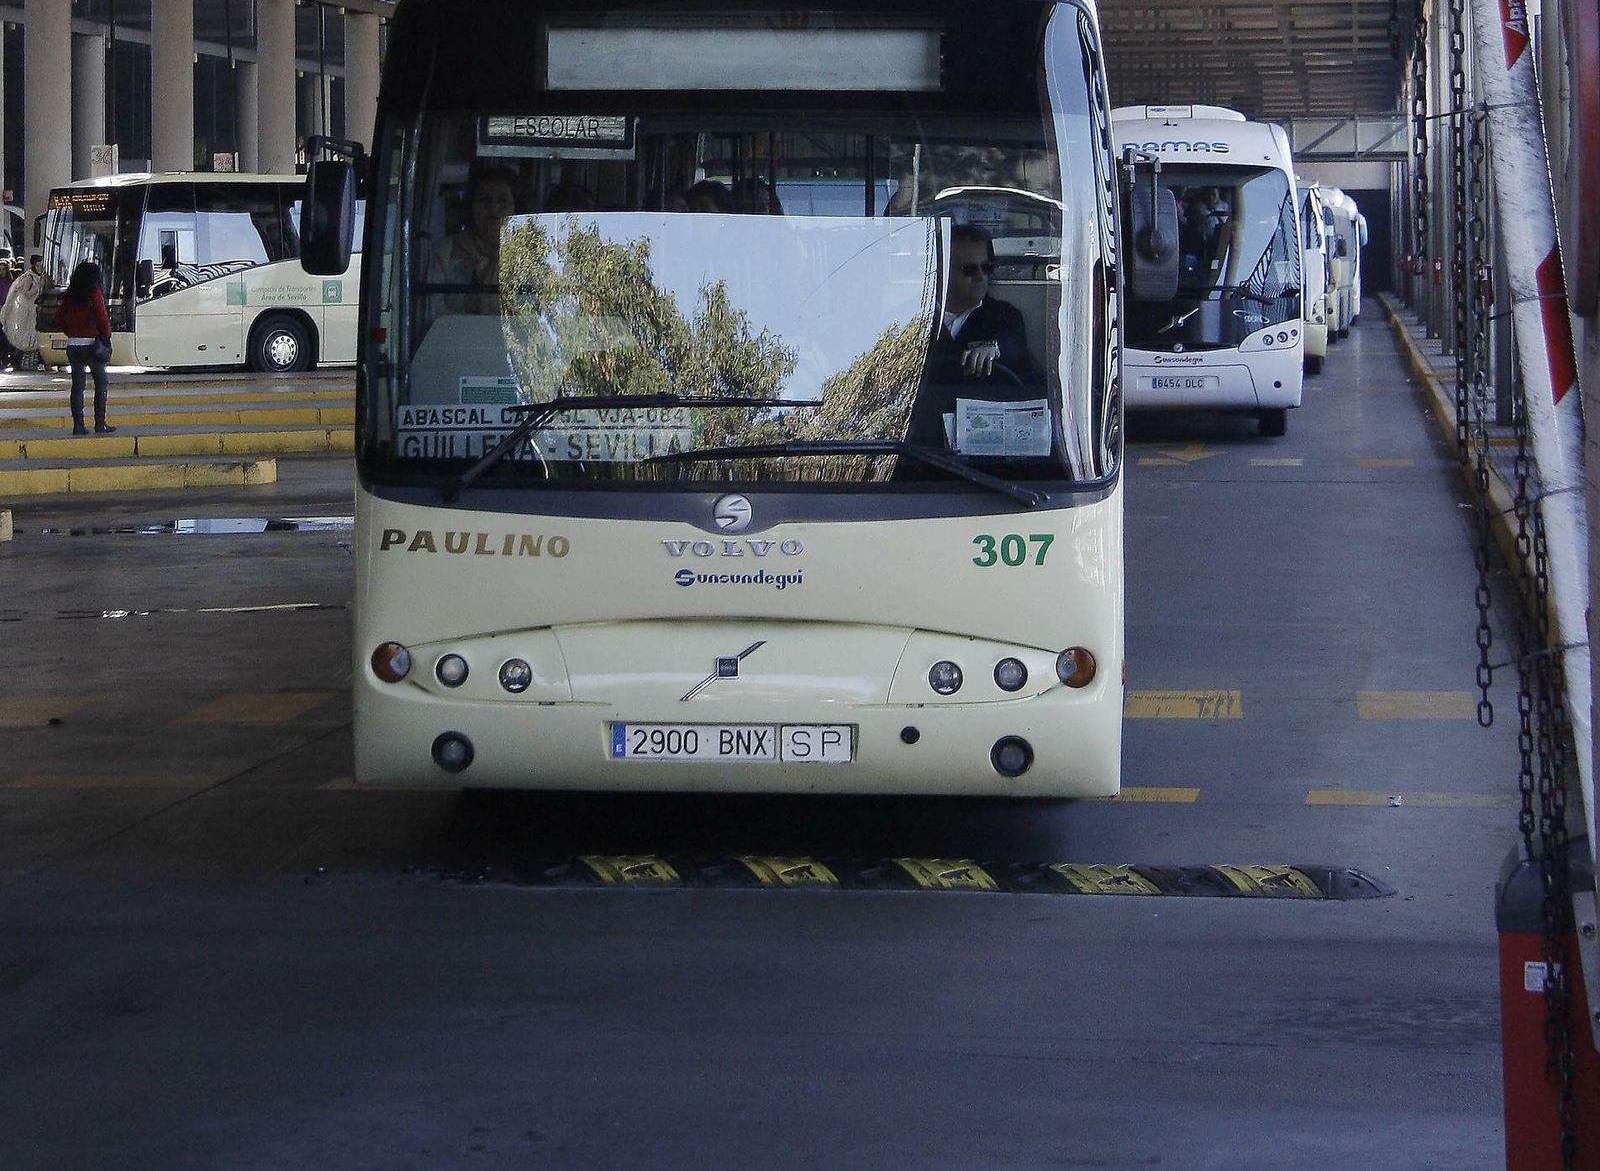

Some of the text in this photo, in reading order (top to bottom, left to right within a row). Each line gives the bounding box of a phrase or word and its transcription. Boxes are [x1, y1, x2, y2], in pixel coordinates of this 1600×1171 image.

[513, 117, 601, 138] ESCOLAR
[1157, 378, 1181, 388] 6454
[402, 408, 493, 426] ABASCAL
[567, 433, 682, 461] SEVILLA
[380, 528, 571, 558] PAULINO
[661, 538, 805, 557] VOLVO
[971, 533, 1055, 567] 307
[675, 568, 803, 590] Sunsundegui
[632, 729, 699, 755] 2900
[719, 729, 768, 756] BNX
